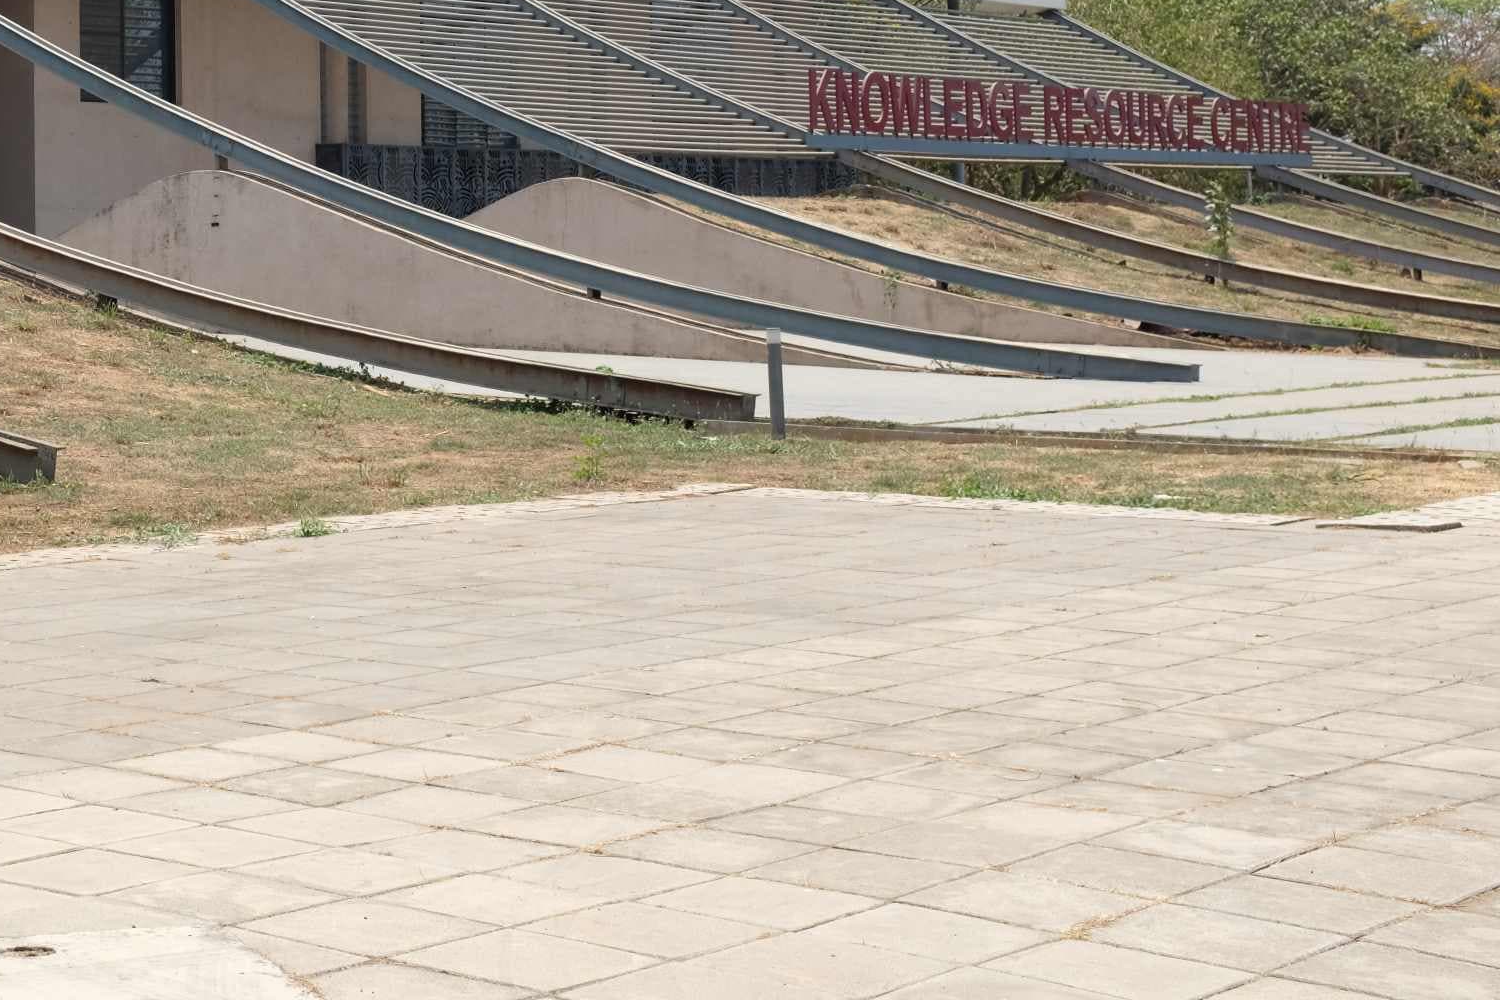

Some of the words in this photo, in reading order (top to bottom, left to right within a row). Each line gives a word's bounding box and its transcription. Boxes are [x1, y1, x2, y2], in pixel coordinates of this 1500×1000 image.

[808, 68, 1035, 143] KNOWLEDGE
[1043, 87, 1204, 151] RESOURCE
[1210, 97, 1311, 153] CENTRE
